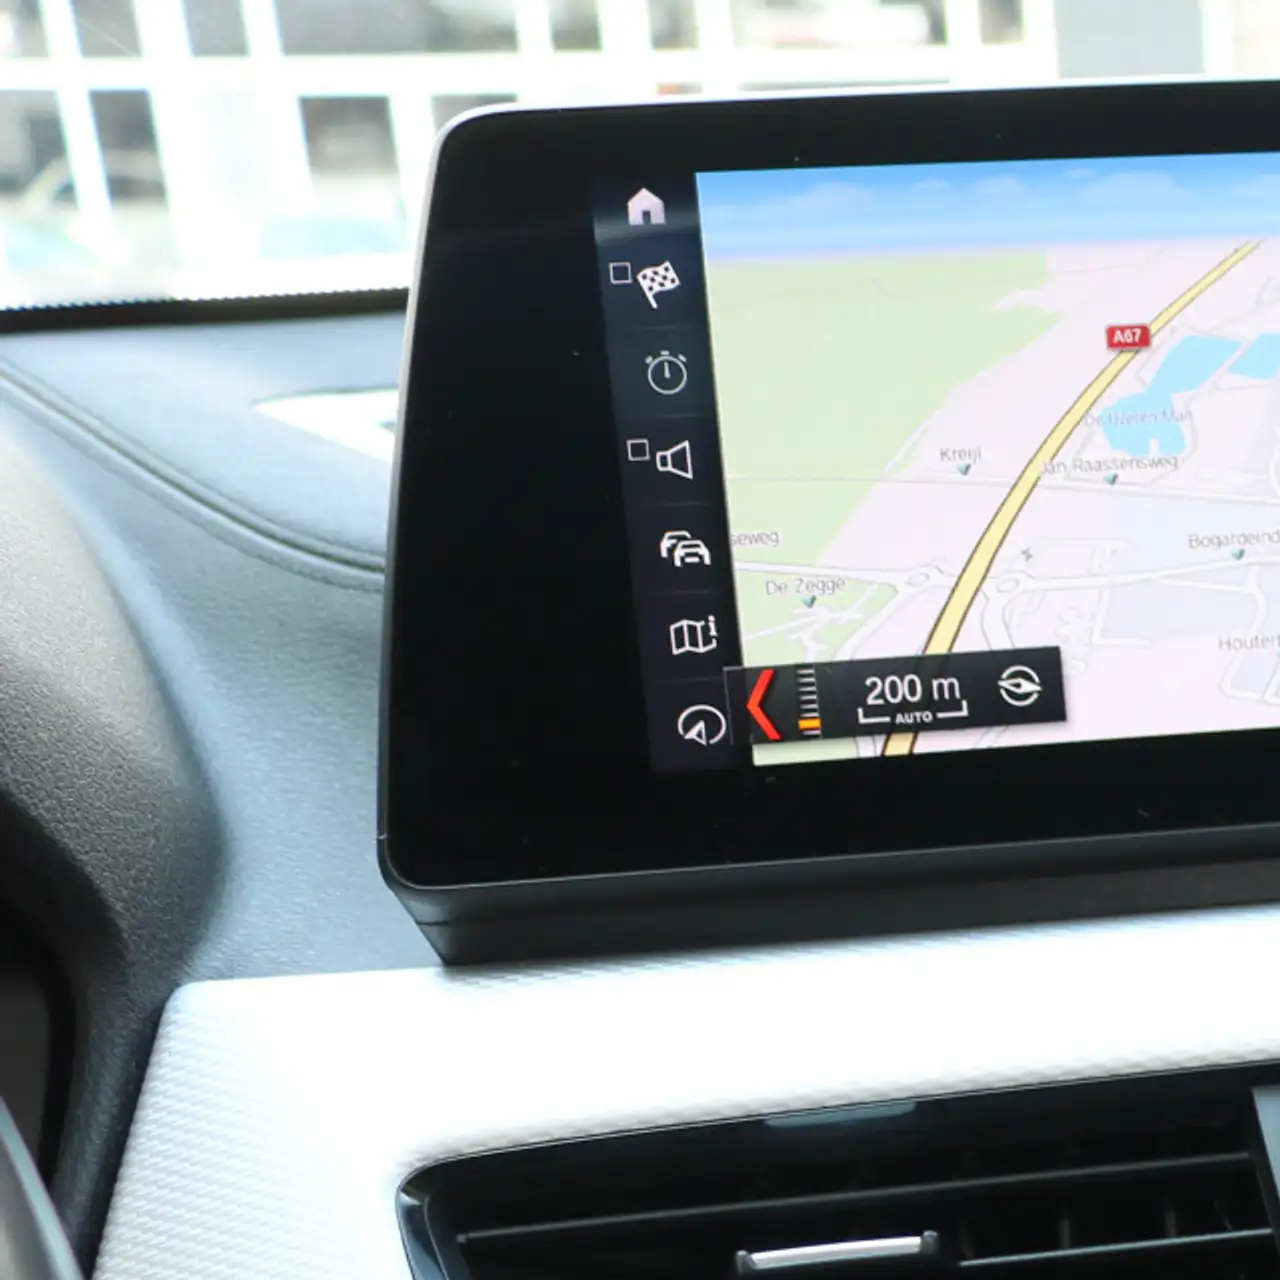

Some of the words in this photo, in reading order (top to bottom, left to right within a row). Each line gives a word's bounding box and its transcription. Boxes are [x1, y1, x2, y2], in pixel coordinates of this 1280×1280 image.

[1112, 327, 1142, 344] A67
[765, 579, 788, 596] De
[795, 578, 846, 597] Zegge
[865, 674, 922, 705] 200
[932, 676, 961, 700] m
[895, 710, 933, 725] AUTO
